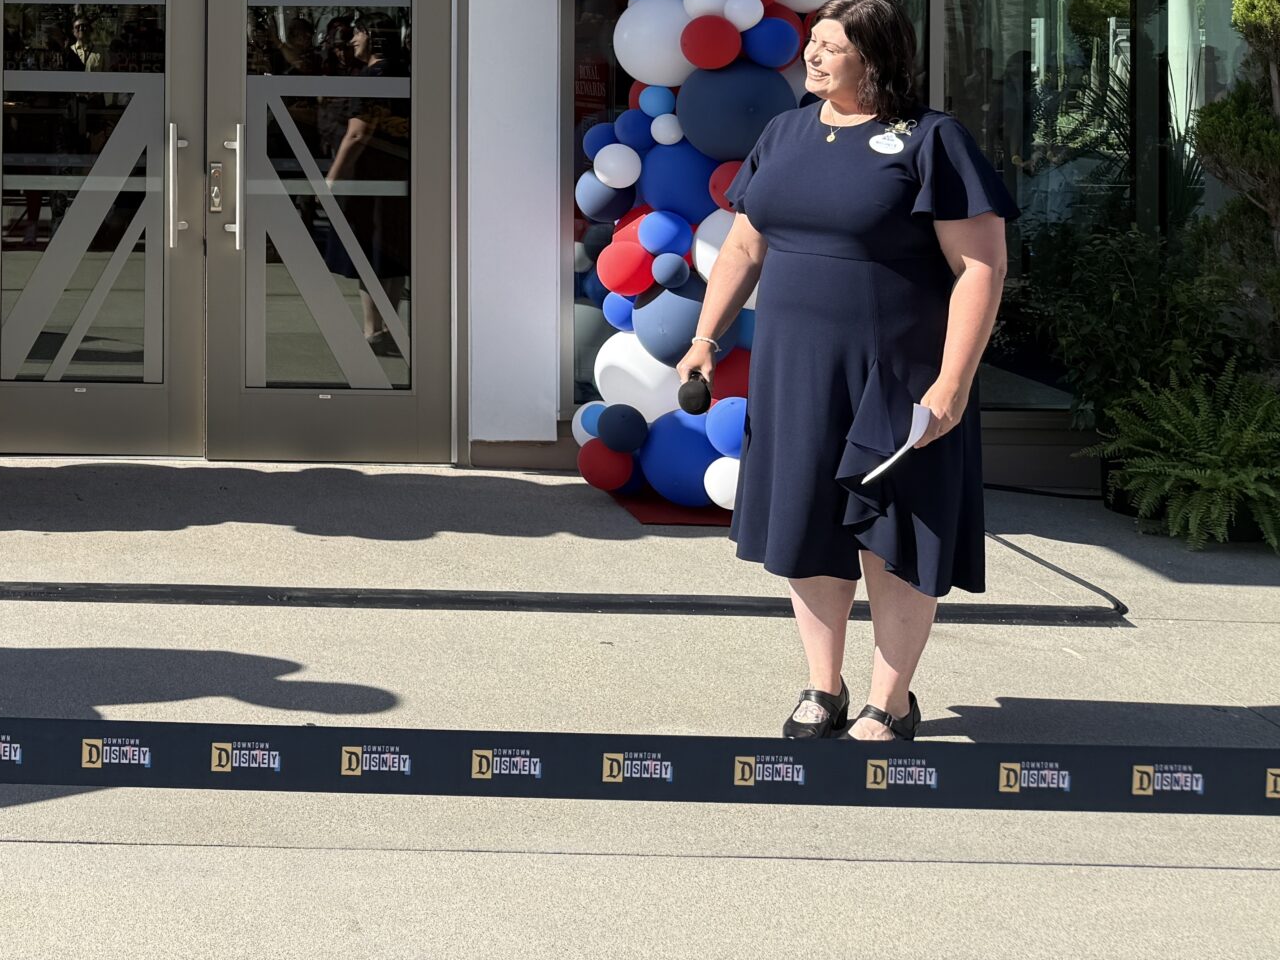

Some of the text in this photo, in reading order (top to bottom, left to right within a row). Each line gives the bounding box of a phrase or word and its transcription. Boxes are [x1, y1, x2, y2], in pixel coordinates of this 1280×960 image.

[104, 738, 140, 746] DOWNTOWN
[363, 745, 400, 753] DOWNTOWN
[85, 743, 148, 765] DISNEY
[214, 746, 278, 768] DISNEY
[344, 750, 408, 772] DISNEY
[475, 753, 539, 775] DISNEY
[625, 752, 662, 760] DOWNTOWN
[606, 757, 670, 779] DISNEY
[737, 760, 802, 782] DISNEY
[869, 763, 935, 785] DISNEY
[1022, 762, 1059, 770] DOWNTOWN
[1155, 765, 1192, 773] DOWNTOWN
[1002, 767, 1068, 789] DISNEY
[1135, 770, 1201, 792] DISNEY
